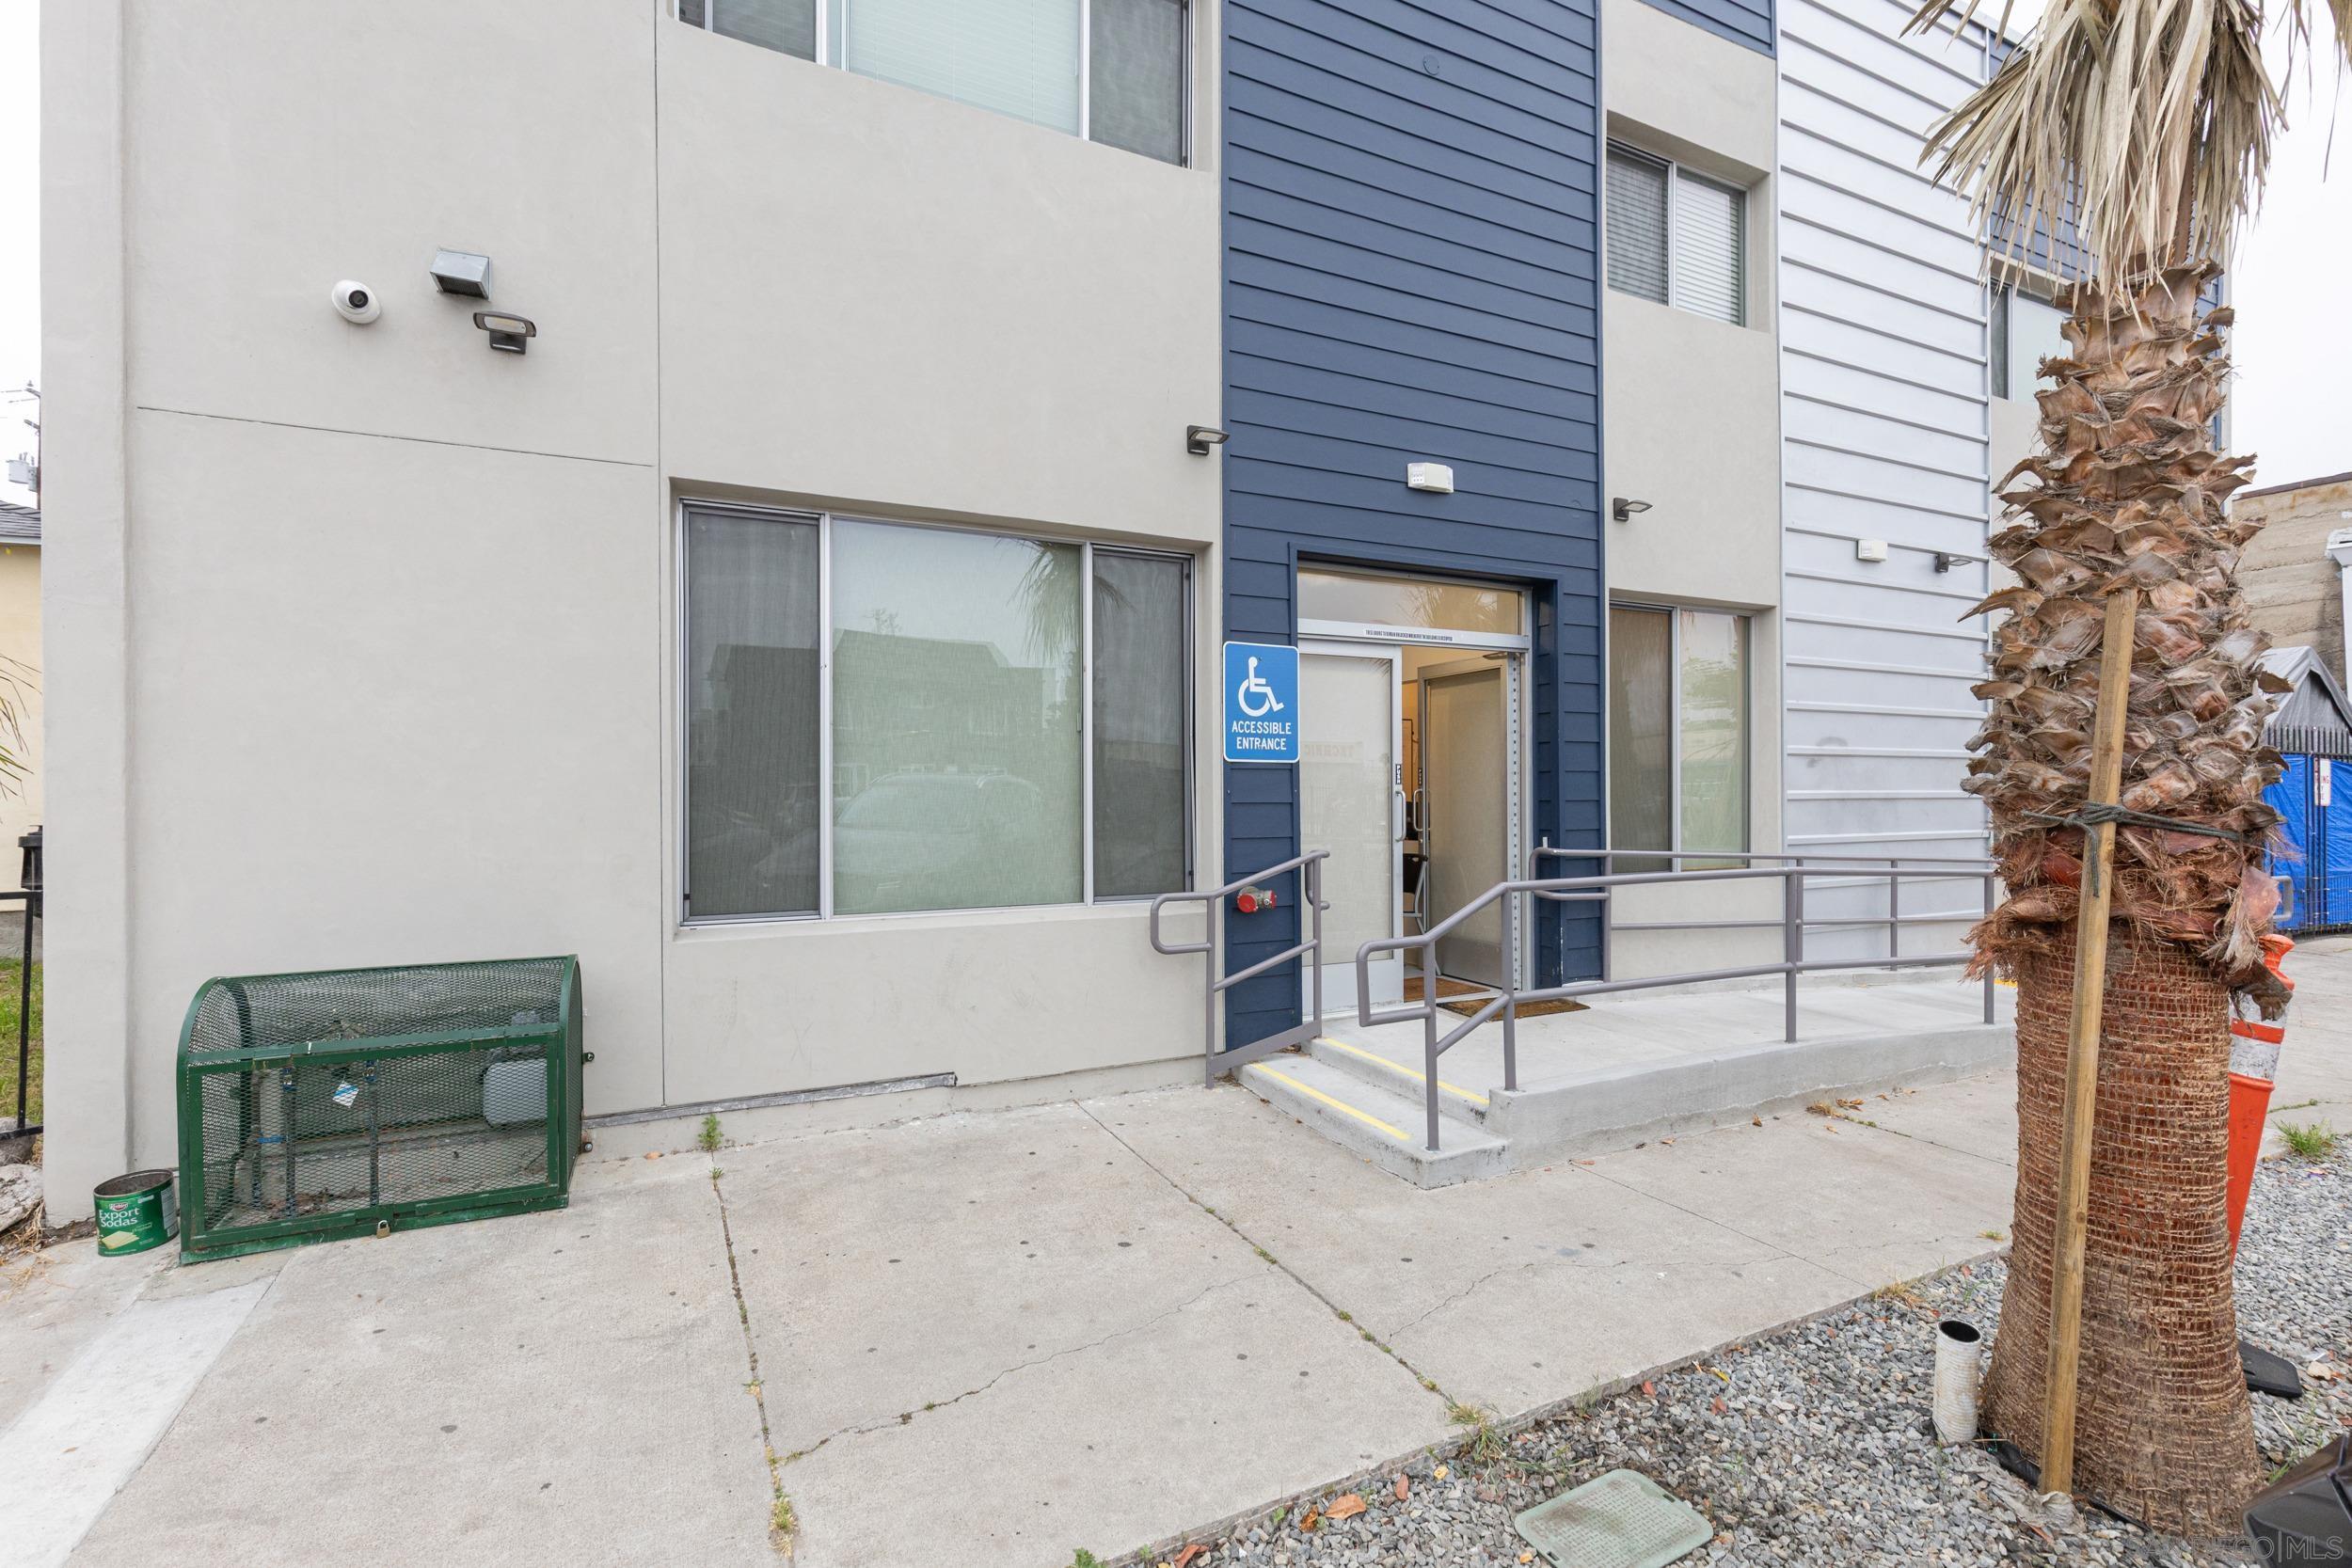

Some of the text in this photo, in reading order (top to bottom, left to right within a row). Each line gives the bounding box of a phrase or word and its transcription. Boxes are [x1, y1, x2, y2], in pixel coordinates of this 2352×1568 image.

[1232, 721, 1292, 735] ACCESSIBLE
[1236, 736, 1287, 751] ENTRANCE
[99, 1208, 140, 1221] Export
[101, 1217, 138, 1227] Sodas
